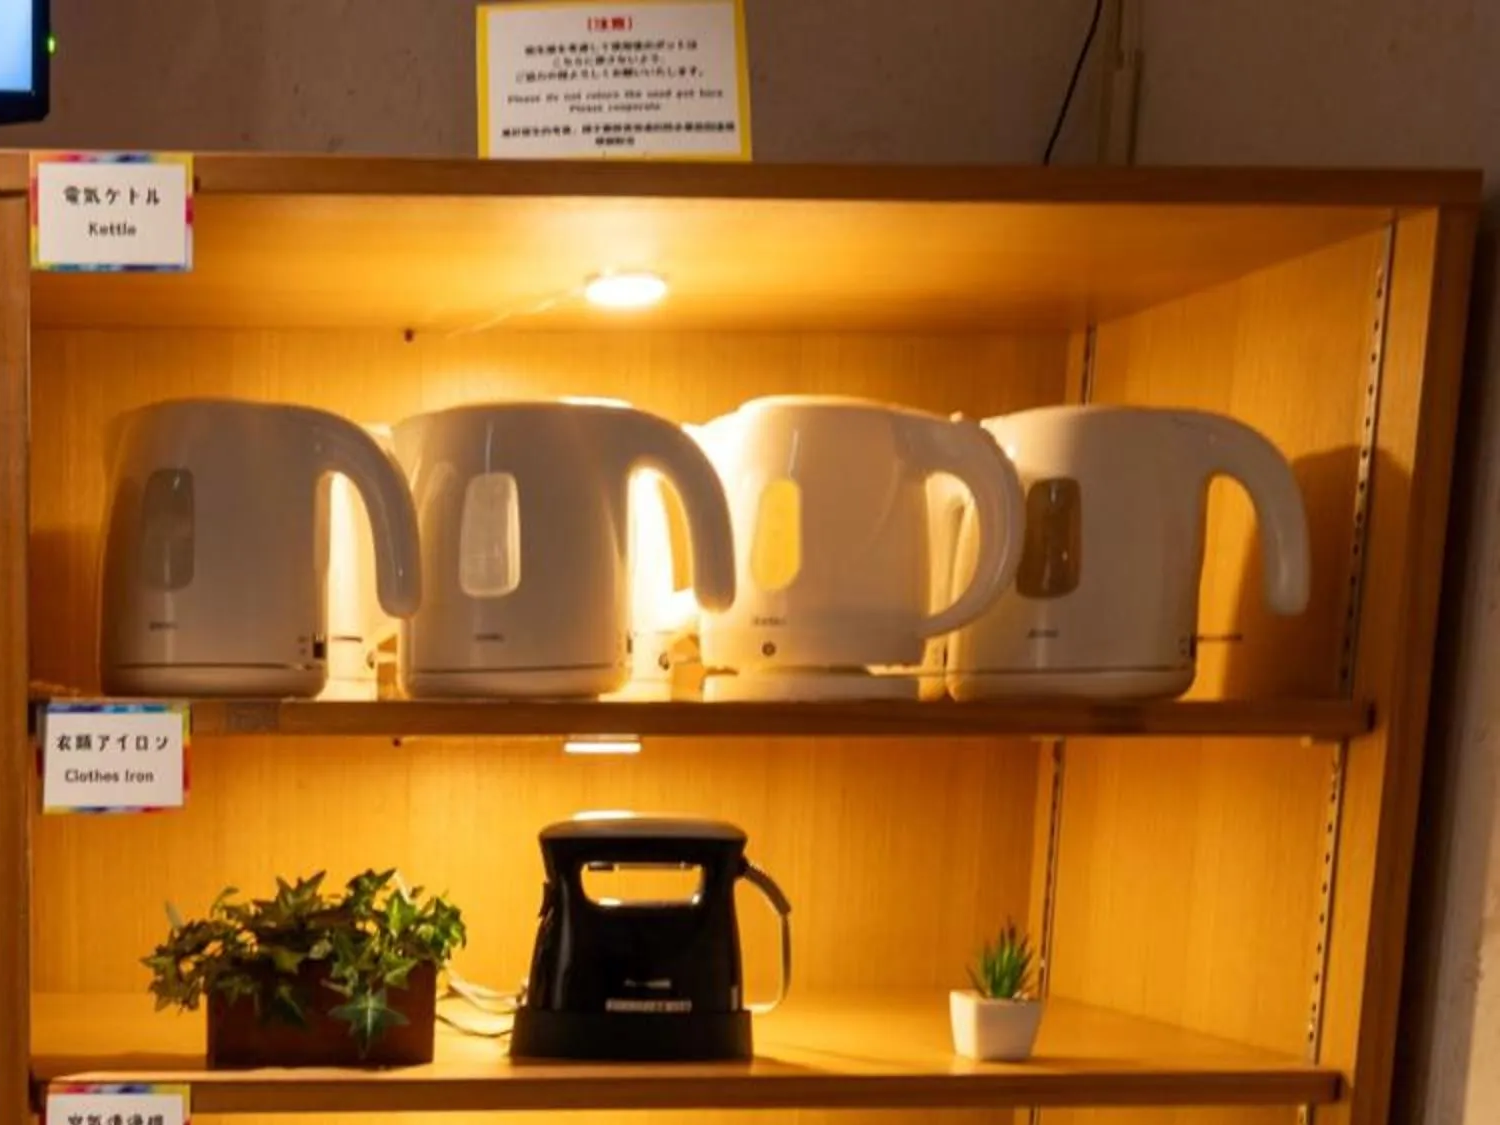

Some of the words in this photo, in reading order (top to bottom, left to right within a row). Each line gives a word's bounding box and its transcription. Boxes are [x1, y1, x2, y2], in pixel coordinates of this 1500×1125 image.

[63, 185, 160, 206] 電気ケトル
[88, 221, 137, 237] Kettle
[56, 733, 169, 752] 衣類アイロン
[64, 768, 120, 783] Clothes
[125, 769, 154, 783] Iron
